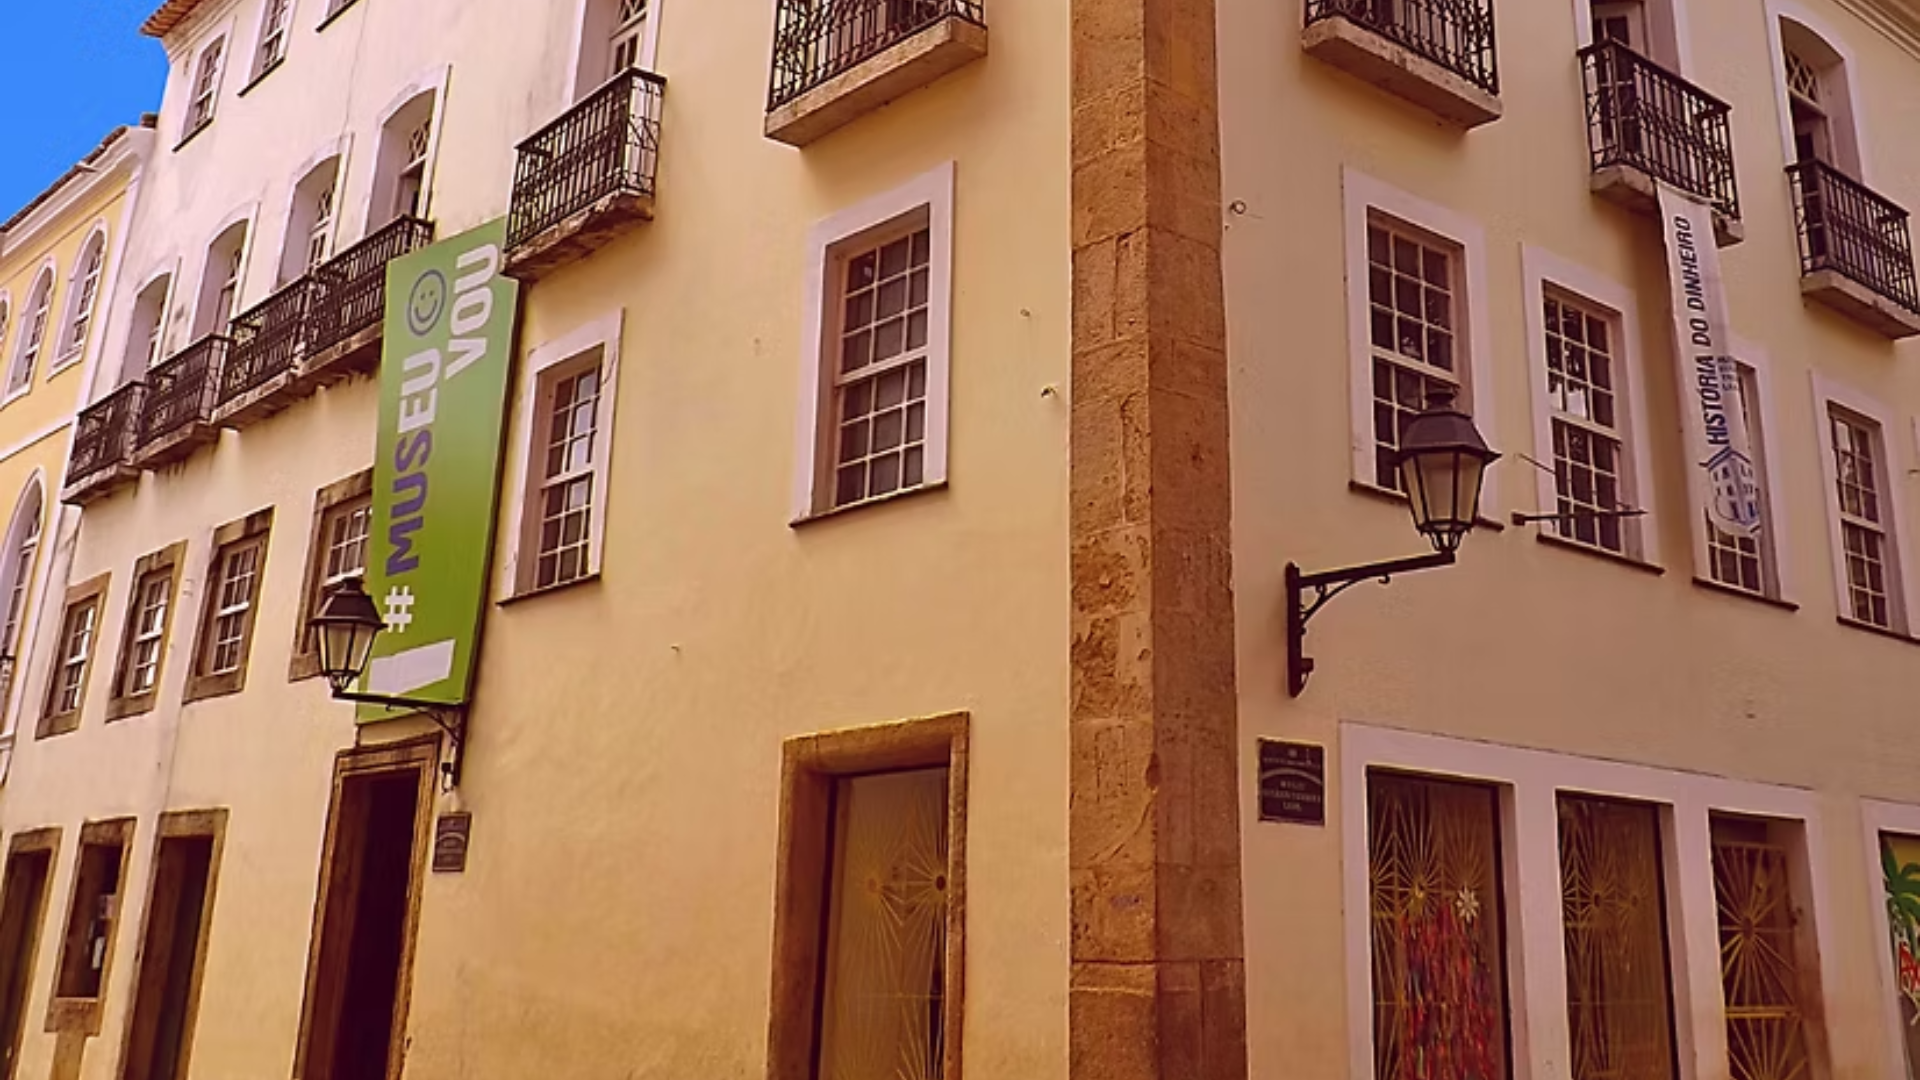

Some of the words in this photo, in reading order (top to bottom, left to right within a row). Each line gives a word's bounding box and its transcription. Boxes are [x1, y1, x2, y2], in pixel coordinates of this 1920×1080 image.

[1674, 216, 1704, 311] DINHEIRO
[445, 243, 499, 380] VOU
[1690, 318, 1712, 347] DO
